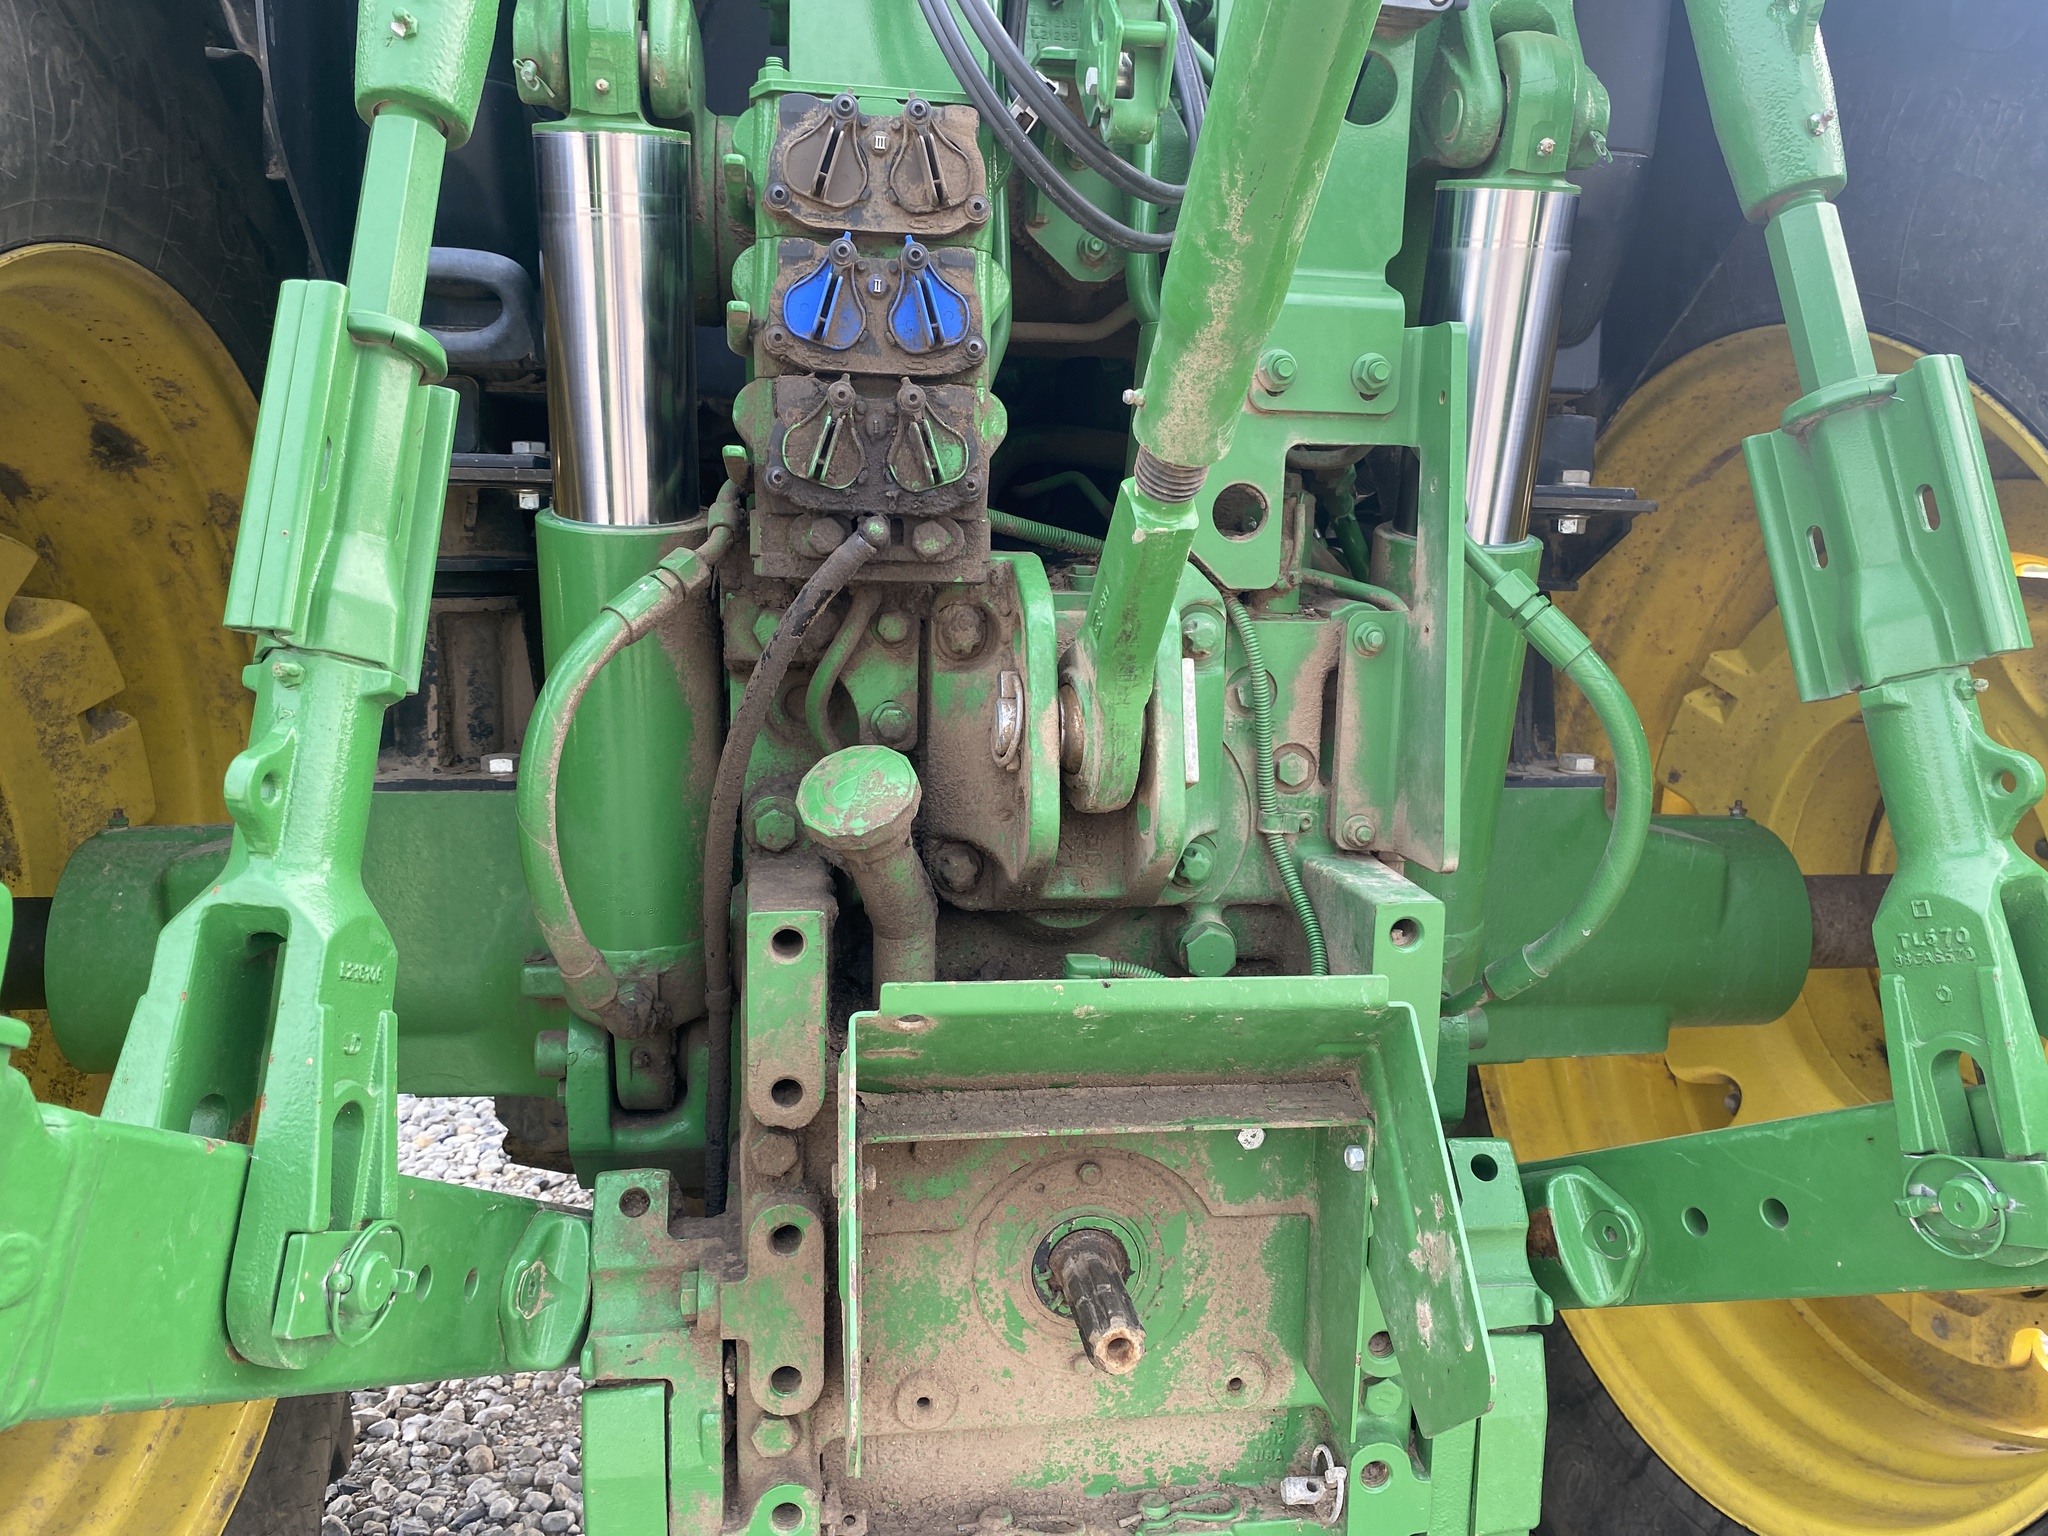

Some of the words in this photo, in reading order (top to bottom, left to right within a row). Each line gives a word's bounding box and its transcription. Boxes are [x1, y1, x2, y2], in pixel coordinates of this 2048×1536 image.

[874, 135, 886, 151] III
[873, 279, 882, 294] II
[1225, 719, 1276, 734] BRAE
[1897, 926, 1972, 950] TL570
